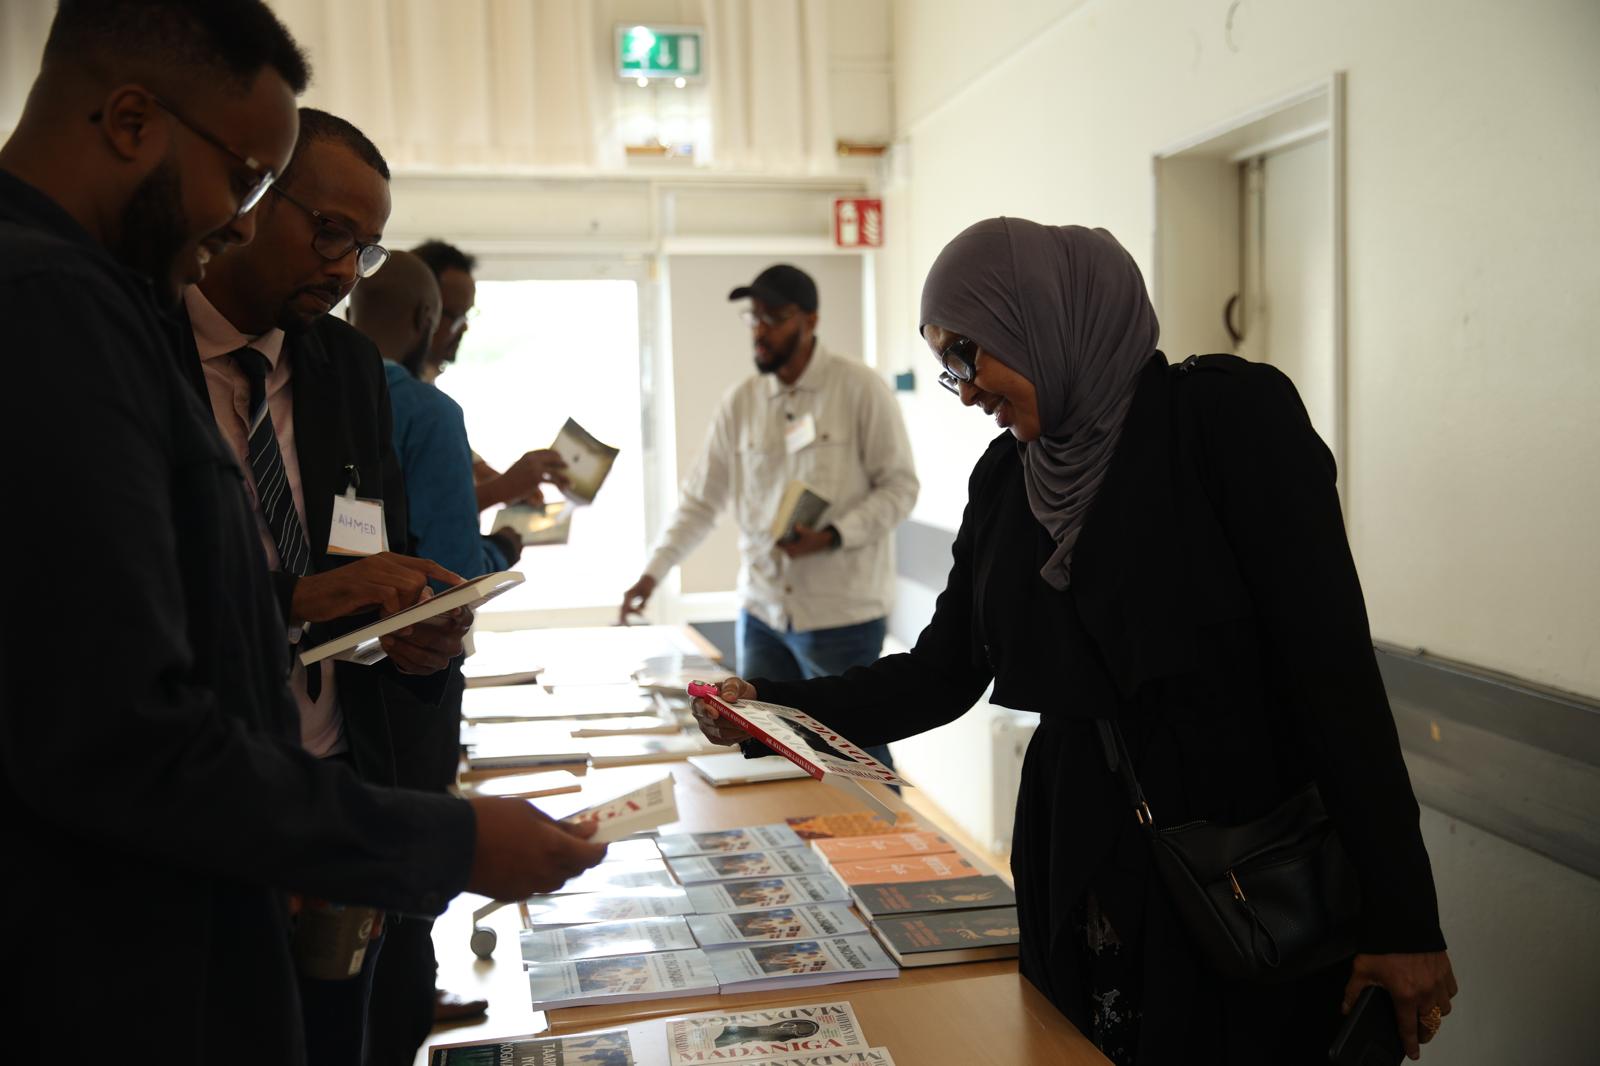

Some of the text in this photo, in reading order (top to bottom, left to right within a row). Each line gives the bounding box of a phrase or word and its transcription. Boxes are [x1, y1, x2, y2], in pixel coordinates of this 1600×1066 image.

[338, 513, 377, 536] AHMED
[689, 1005, 844, 1028] MADANIGA
[500, 1042, 514, 1066] XOGW
[679, 1037, 844, 1063] MADANIGA
